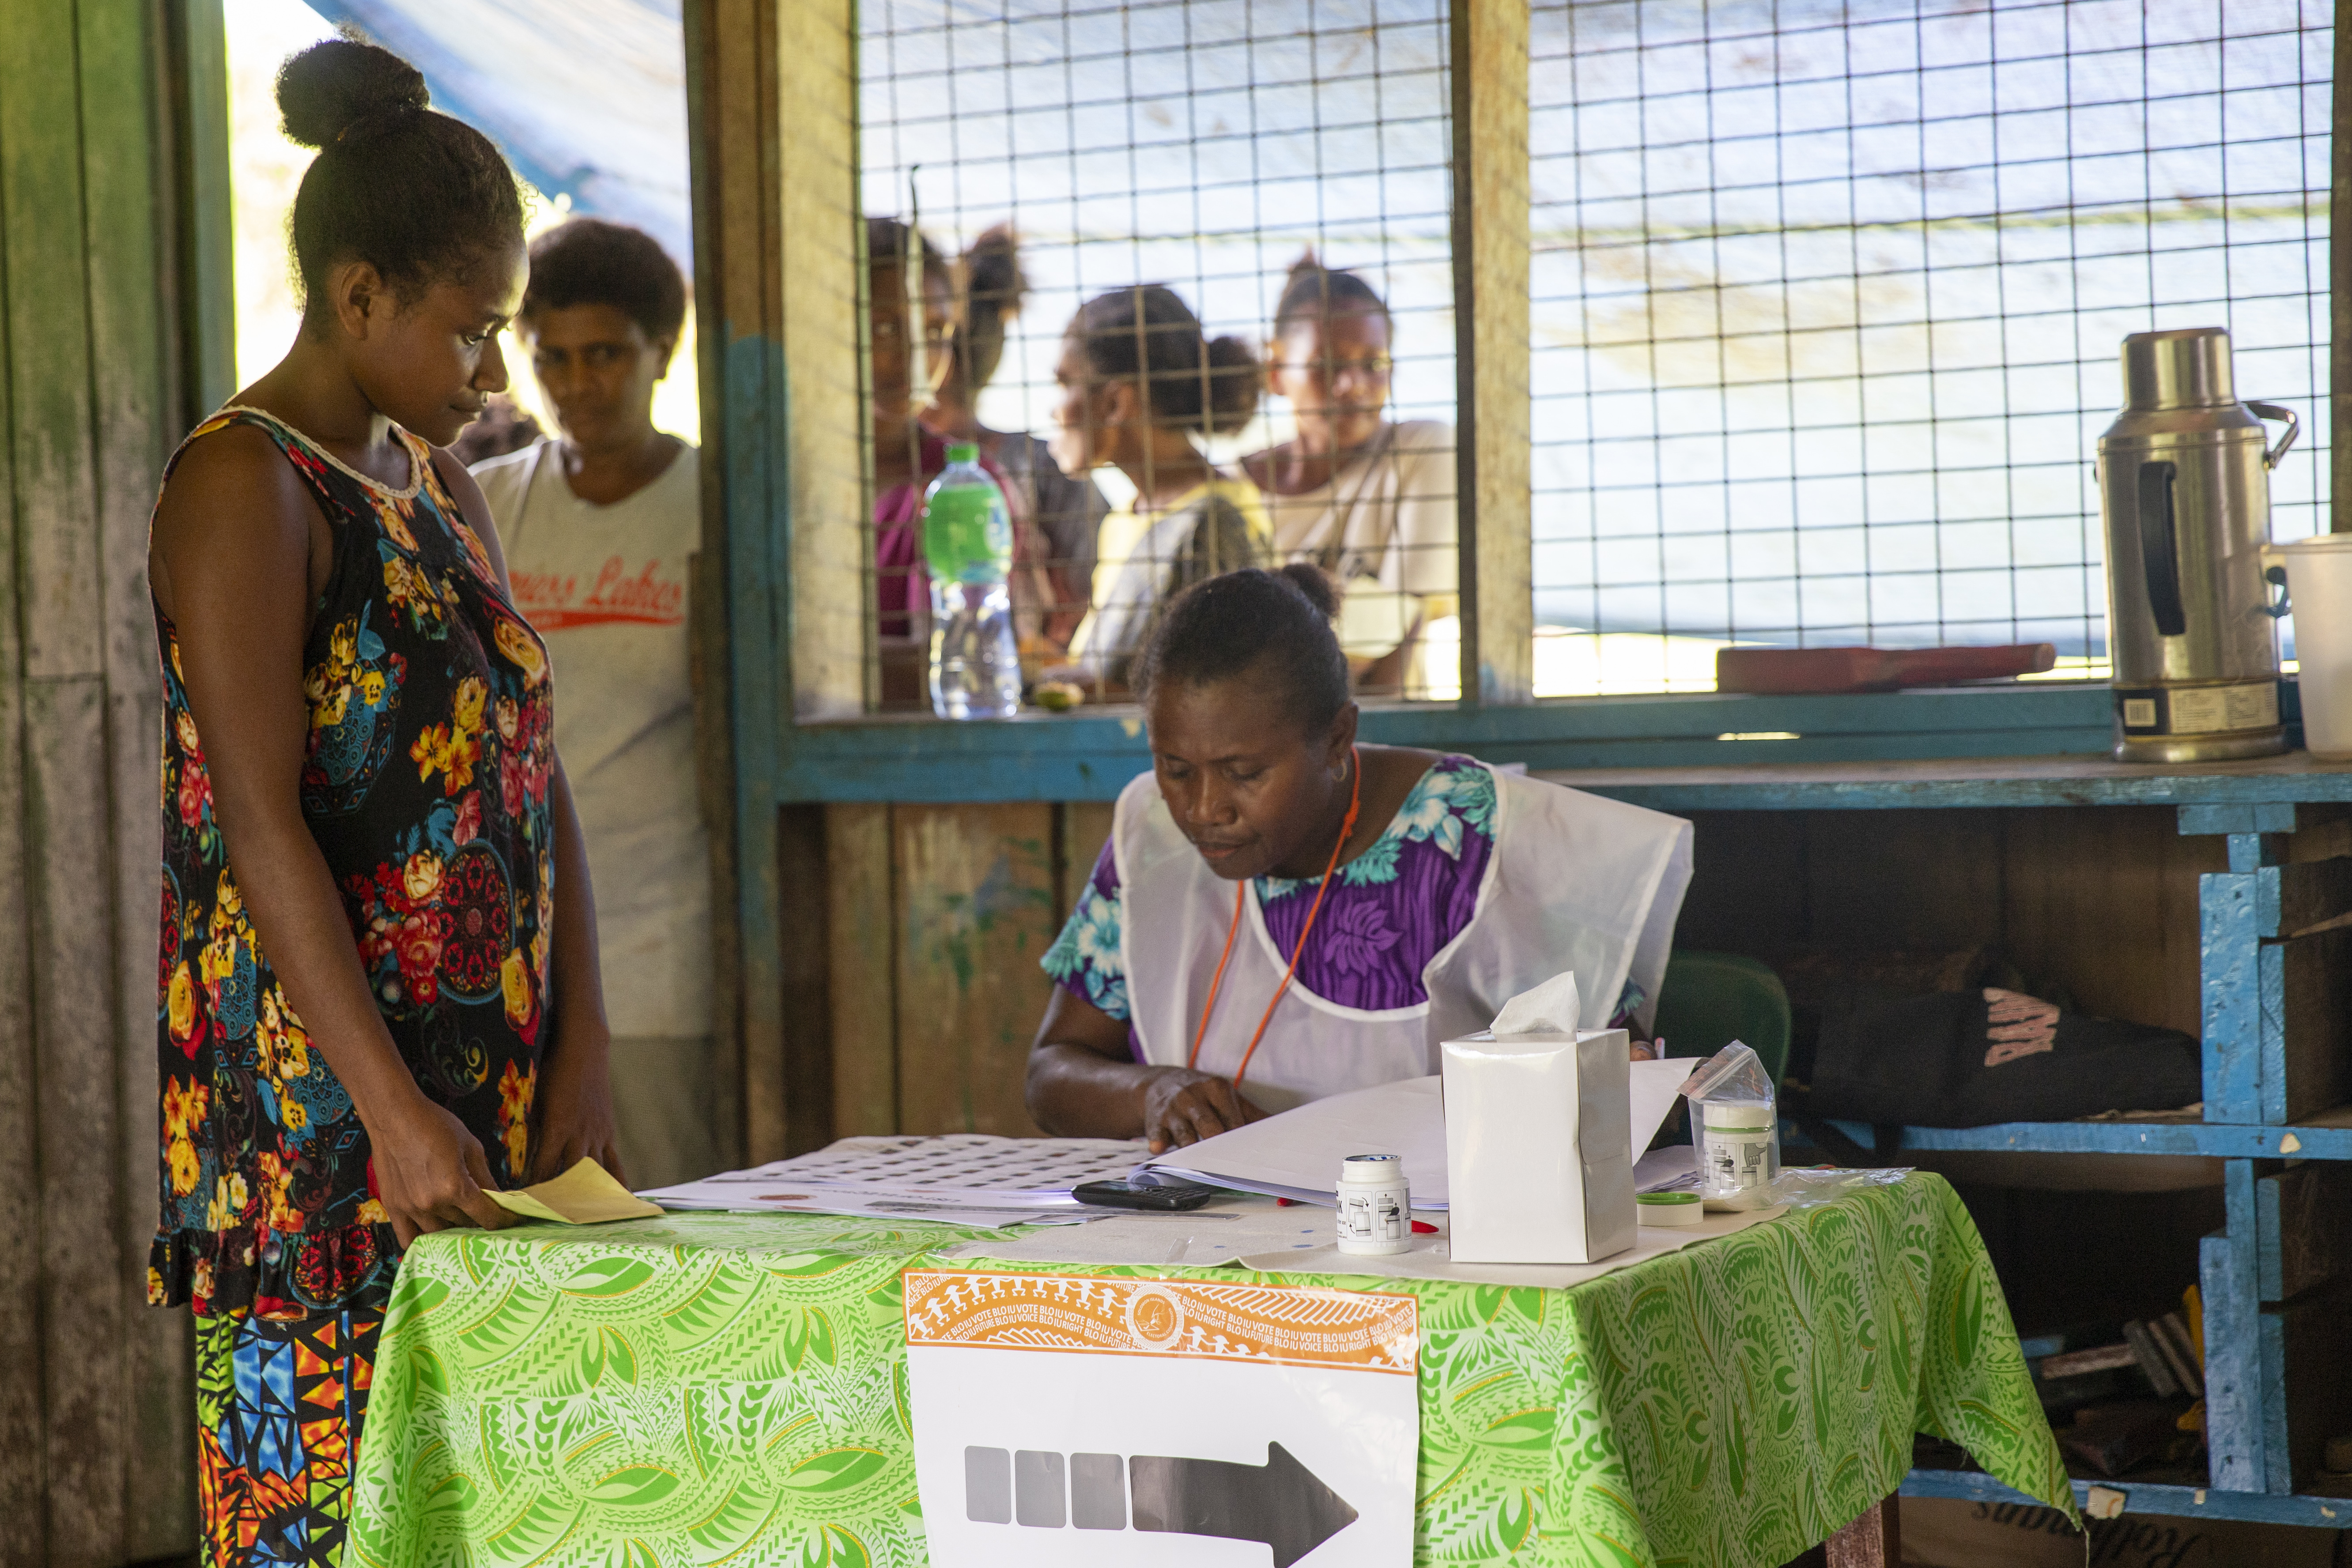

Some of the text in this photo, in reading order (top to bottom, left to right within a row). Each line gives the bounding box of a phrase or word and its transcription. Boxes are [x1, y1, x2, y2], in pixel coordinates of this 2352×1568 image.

[908, 1294, 922, 1307] OICE
[920, 1282, 933, 1296] BLO
[932, 1278, 940, 1287] IU
[915, 1275, 929, 1289] BLO
[1137, 1298, 1149, 1315] SOLOMON
[1182, 1296, 1197, 1308] BLO
[1197, 1302, 1205, 1312] IU
[1207, 1305, 1227, 1320] VOTE
[1228, 1313, 1242, 1325] BLO
[1243, 1319, 1251, 1329] IU
[1253, 1321, 1274, 1335] VOTE
[1275, 1327, 1289, 1338] BLO
[1291, 1331, 1299, 1340] IU
[1299, 1331, 1321, 1342] VOTE
[1323, 1333, 1338, 1342] BLO
[1339, 1333, 1347, 1342] IU
[1347, 1328, 1370, 1342] VOTE
[1369, 1323, 1384, 1337] BLO
[1391, 1305, 1412, 1325] VOTE
[951, 1323, 964, 1336] BLO
[963, 1318, 972, 1328] IU
[970, 1309, 993, 1323] VOTE
[992, 1306, 1007, 1316] BLO
[1008, 1305, 1015, 1314] IU
[1016, 1304, 1038, 1313] VOTE
[1040, 1305, 1054, 1315] BLO
[1055, 1308, 1063, 1318] IU
[1065, 1311, 1085, 1325] VOTE
[1086, 1318, 1101, 1330] BLO
[1101, 1324, 1110, 1334] IU
[1111, 1327, 1133, 1343] VOTE
[968, 1327, 976, 1337] IU
[975, 1318, 995, 1332] FUTURE
[995, 1315, 1008, 1326] BLO
[1009, 1315, 1016, 1323] IU
[1017, 1313, 1038, 1322] VOICE
[1039, 1315, 1053, 1324] BLO
[1054, 1318, 1062, 1327] IU
[1062, 1321, 1084, 1333] RIGHT
[1084, 1328, 1099, 1339] BLO
[1099, 1334, 1108, 1343] IU
[1195, 1311, 1203, 1321] IU
[1204, 1315, 1225, 1329] RIGHT
[1227, 1323, 1241, 1335] BLO
[1242, 1328, 1250, 1338] IU
[1250, 1331, 1273, 1344] FUTURE
[1274, 1337, 1289, 1348] BLO
[1290, 1340, 1298, 1350] IU
[1299, 1342, 1321, 1352] VOICE
[1323, 1342, 1339, 1352] BLO
[1340, 1343, 1348, 1352] IU
[1349, 1338, 1370, 1351] RIGHT
[1372, 1333, 1388, 1346] BLO
